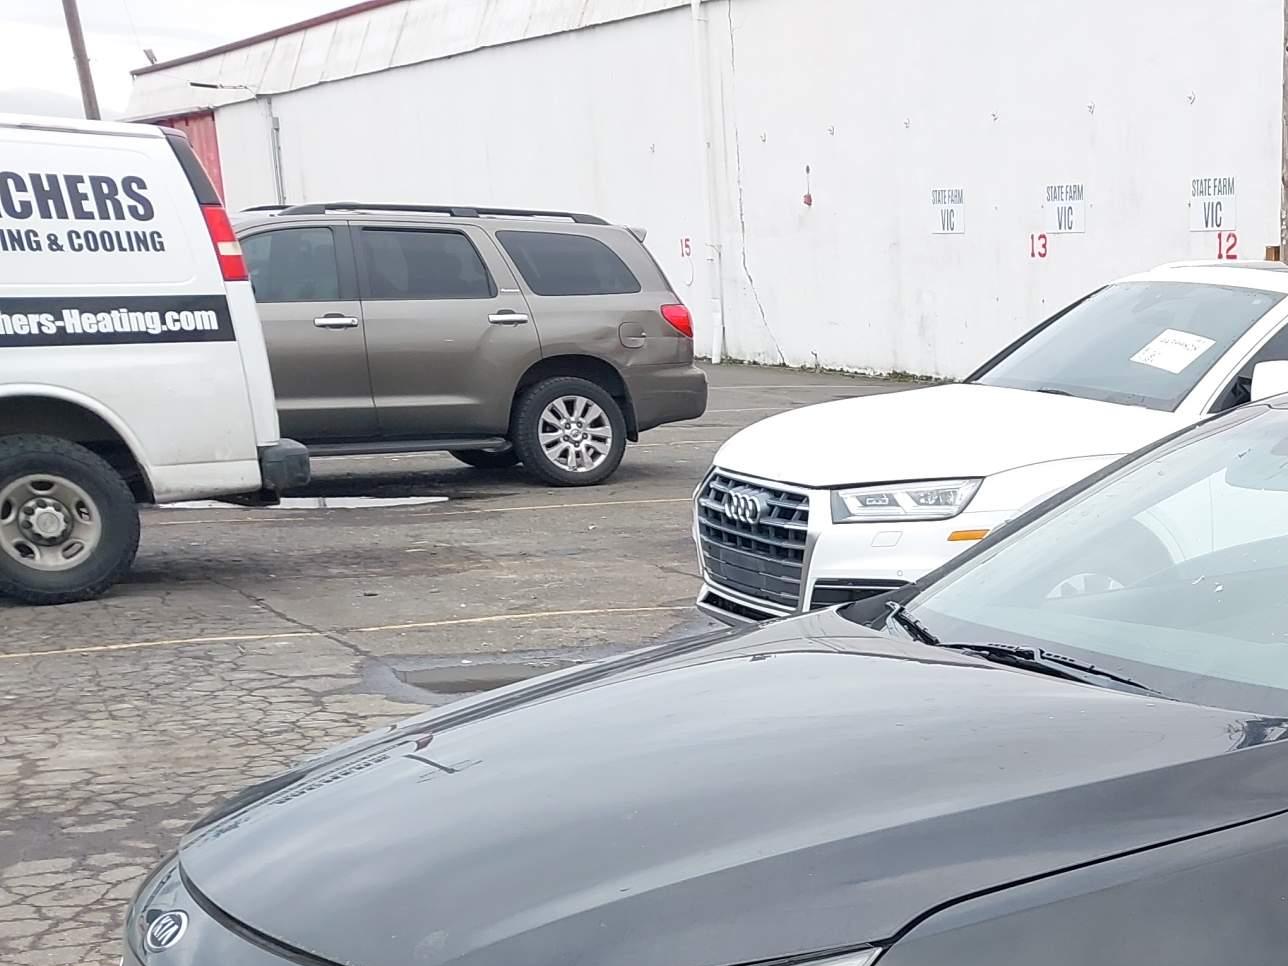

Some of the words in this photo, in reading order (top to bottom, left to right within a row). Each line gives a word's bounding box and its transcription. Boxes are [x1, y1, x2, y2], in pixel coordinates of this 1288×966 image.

[0, 171, 155, 221] CHERS
[932, 189, 947, 205] STATE
[948, 188, 964, 204] FARM
[1046, 185, 1064, 201] STATE
[1065, 184, 1084, 201] FARM
[1191, 178, 1211, 197] STATE
[1213, 177, 1235, 196] FARM
[941, 208, 955, 231] VIC
[1057, 206, 1073, 230] VIC
[1203, 201, 1222, 228] VIC
[47, 233, 64, 251] &
[67, 230, 166, 252] COOLING
[680, 238, 692, 257] 15
[1030, 234, 1048, 258] 13
[1217, 232, 1237, 259] 12
[152, 915, 180, 946] KIA
